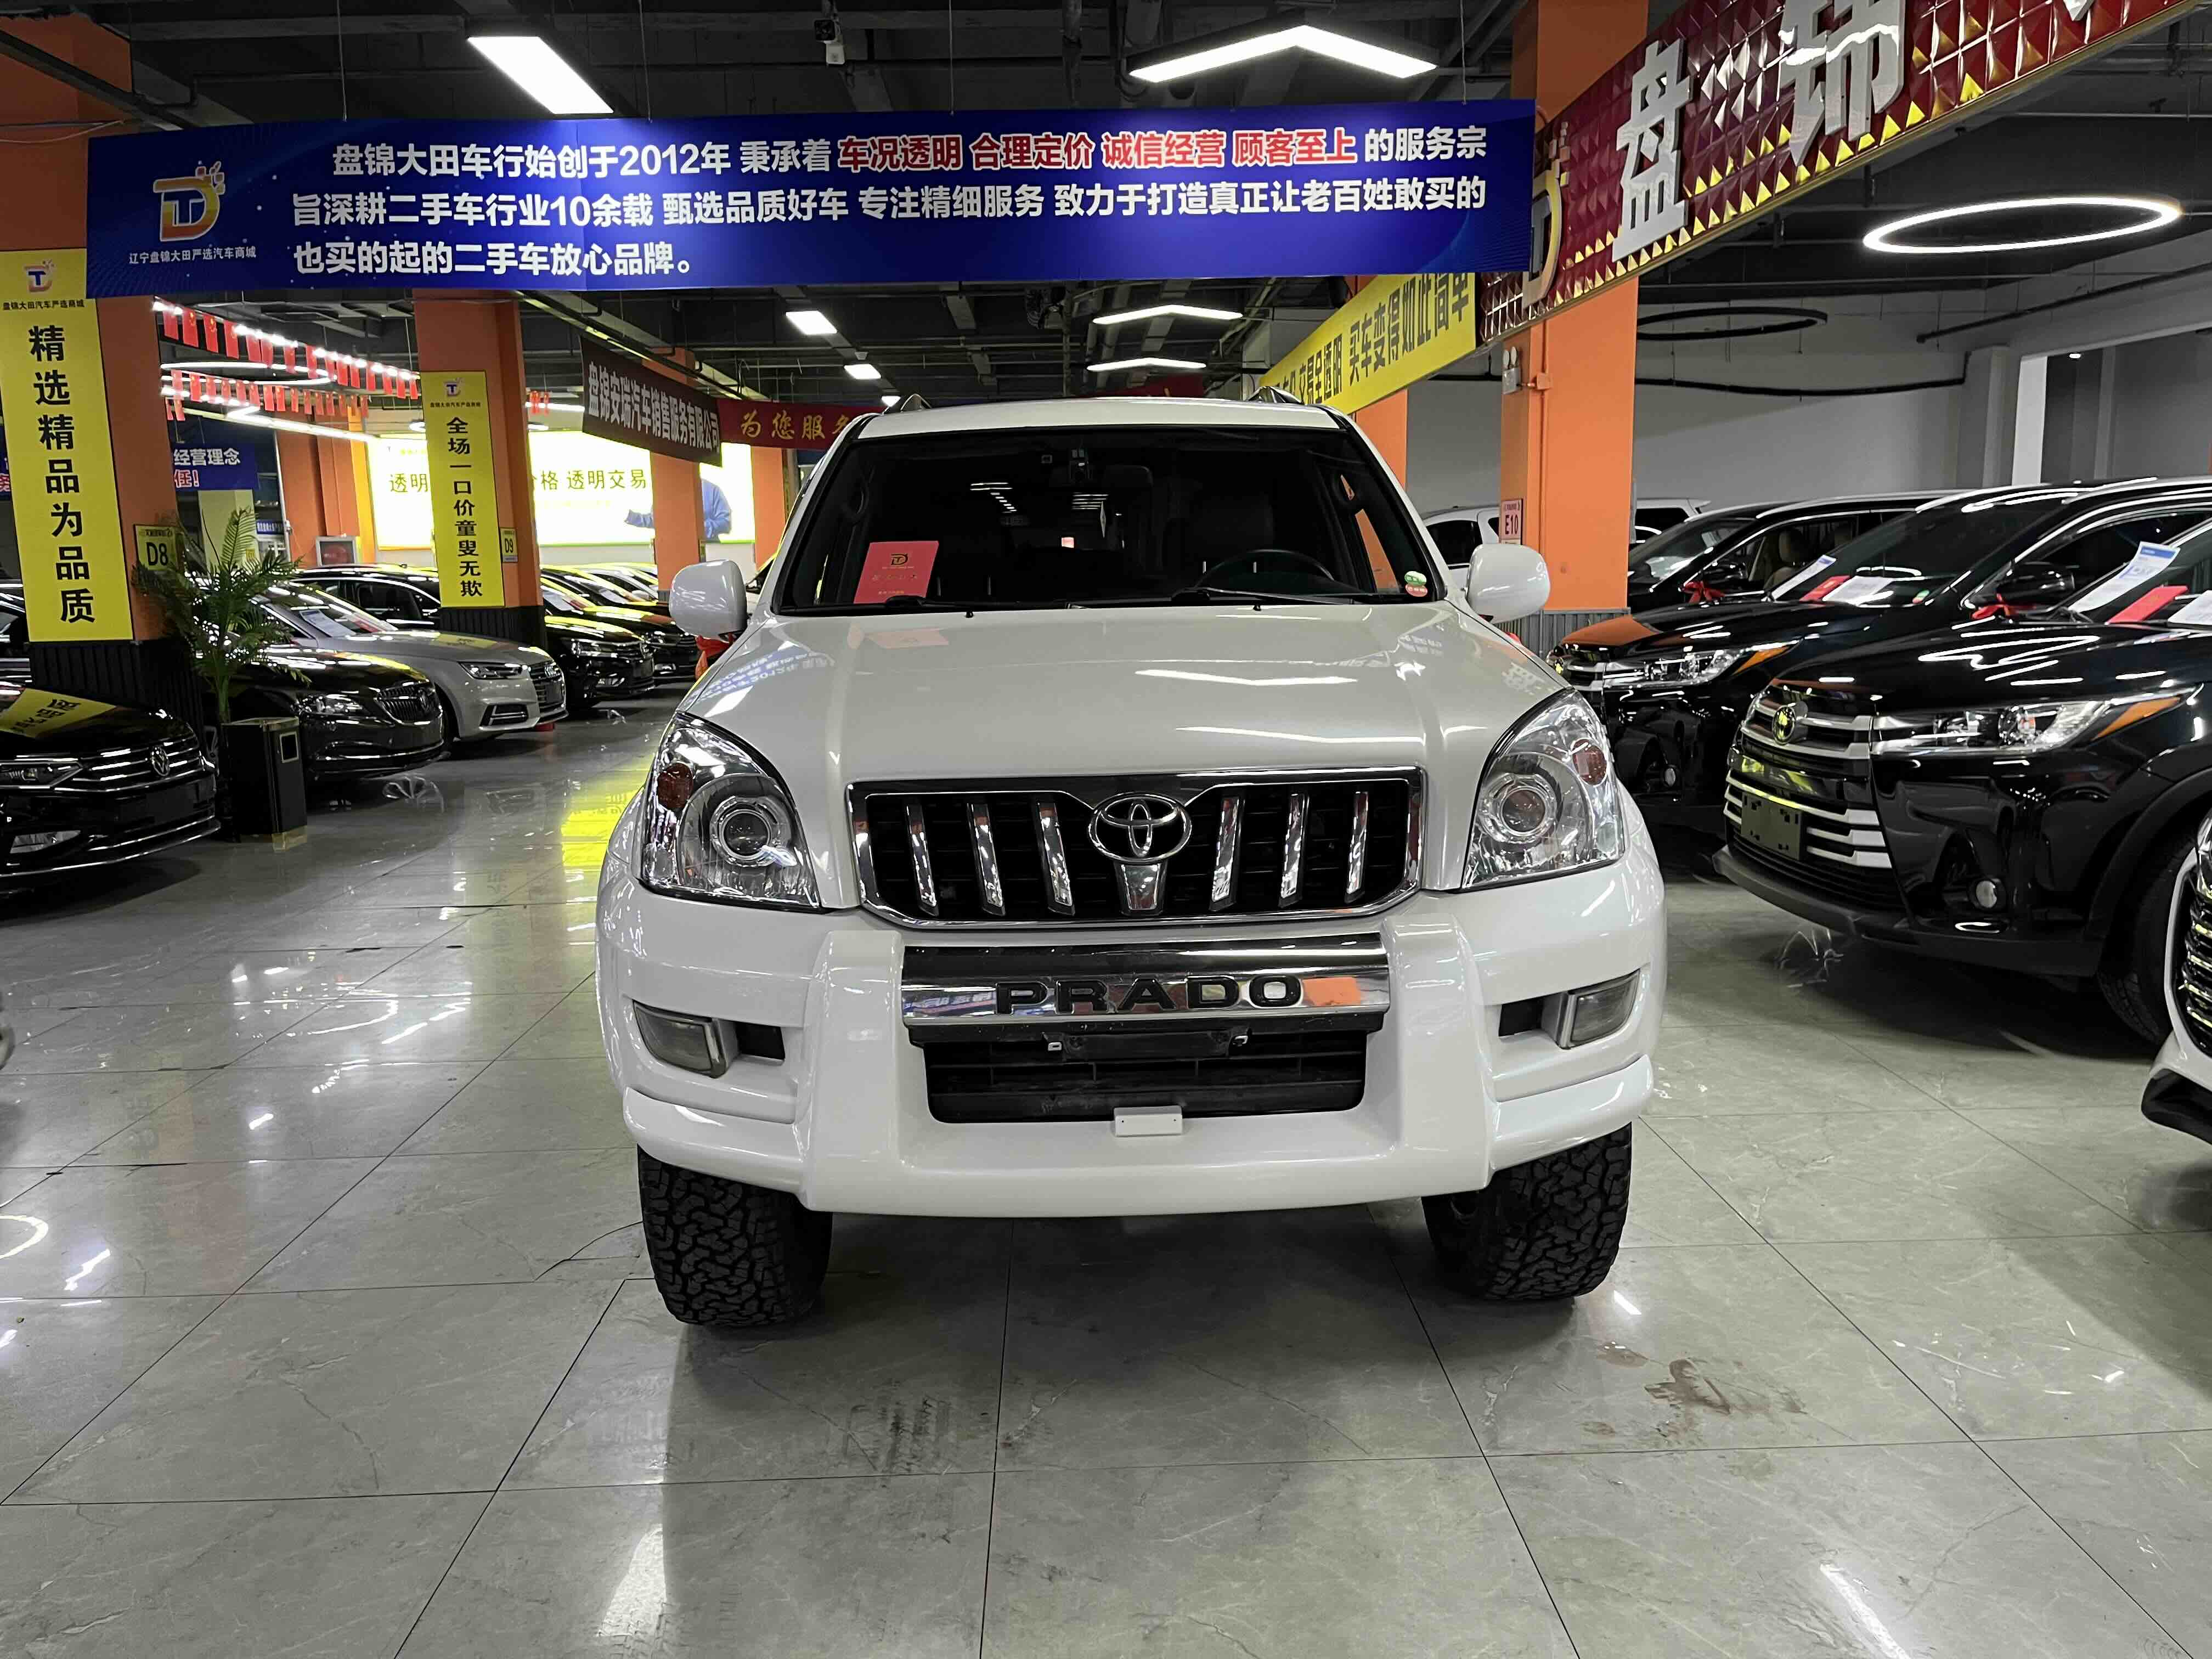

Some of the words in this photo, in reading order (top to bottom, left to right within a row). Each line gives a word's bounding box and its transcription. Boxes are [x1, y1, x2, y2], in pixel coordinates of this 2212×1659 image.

[332, 142, 730, 177] 盘锦大田车行始创于2012年
[740, 139, 832, 174] 秉承着
[837, 134, 964, 173] 车况透明
[969, 132, 1096, 171] 合理定价
[1101, 129, 1227, 169] 诚信经营
[1231, 127, 1357, 167] 顾客至上
[1364, 126, 1486, 161] 的服务宗
[292, 191, 653, 227] 旨深耕二手车行业10余载
[662, 187, 849, 225] 甄选品质好车
[858, 184, 1045, 220] 专注精细服务
[1053, 175, 1486, 217] 致力于打造真正让老百姓敢买的
[129, 246, 257, 264] 辽宁盘锦大田严选汽车商城
[294, 240, 690, 276] 也买的起的二手车放心品牌。
[173, 448, 241, 466] 经营理念
[29, 325, 95, 623] 精选精品为品质
[388, 473, 428, 493] 透明
[566, 469, 647, 490] 透明交易
[446, 417, 483, 597] 全场一口价童叟无欺
[1505, 515, 1519, 534] E10
[146, 541, 168, 566] D8
[504, 538, 514, 553] D9
[995, 975, 1304, 1015] PRADO
